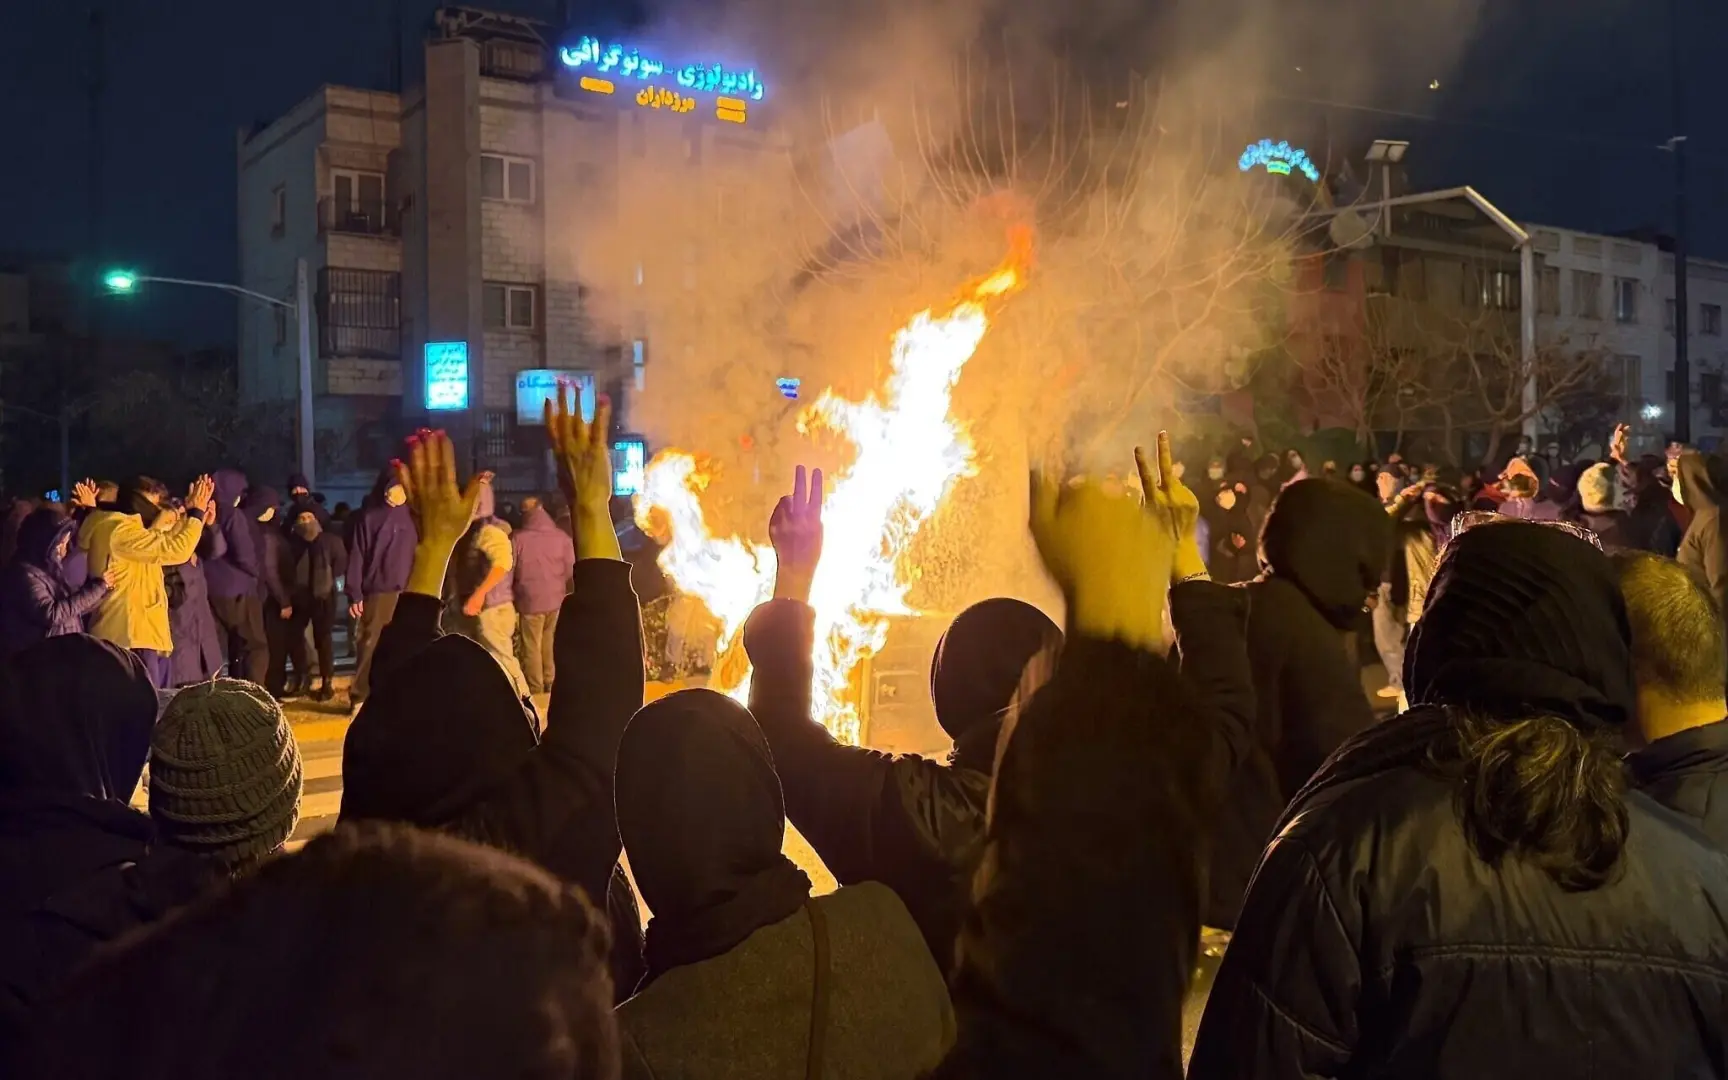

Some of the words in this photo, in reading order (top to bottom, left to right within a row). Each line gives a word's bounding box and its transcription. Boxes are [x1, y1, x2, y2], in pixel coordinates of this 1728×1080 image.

[560, 35, 664, 80] سونوگرافی
[635, 85, 696, 113] مرزداران
[676, 62, 765, 101] رادیولوژی
